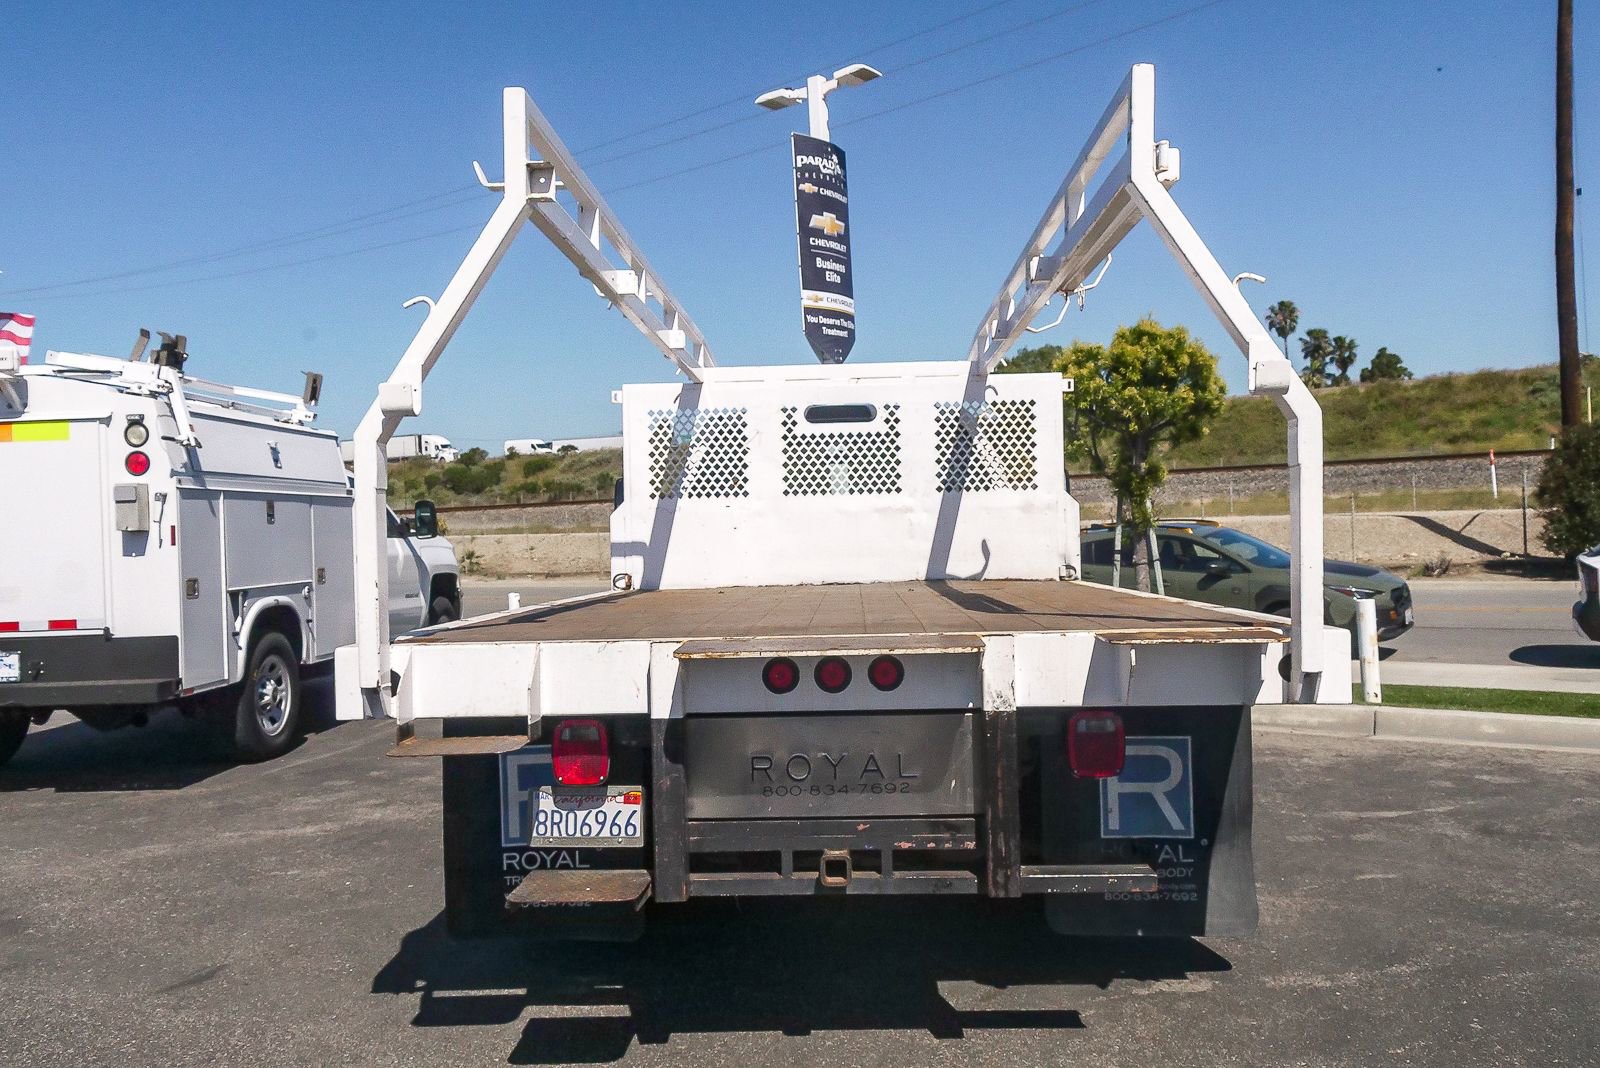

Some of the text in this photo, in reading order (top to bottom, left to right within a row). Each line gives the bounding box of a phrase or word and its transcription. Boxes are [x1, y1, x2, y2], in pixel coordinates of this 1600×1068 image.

[809, 237, 847, 253] CHEVROLET
[816, 257, 846, 273] Business
[825, 271, 842, 284] Elite
[806, 314, 818, 323] You
[819, 316, 840, 326] Deserve
[751, 753, 920, 781] ROYAL
[535, 809, 638, 837] 8R06966
[503, 850, 590, 871] ROYAL
